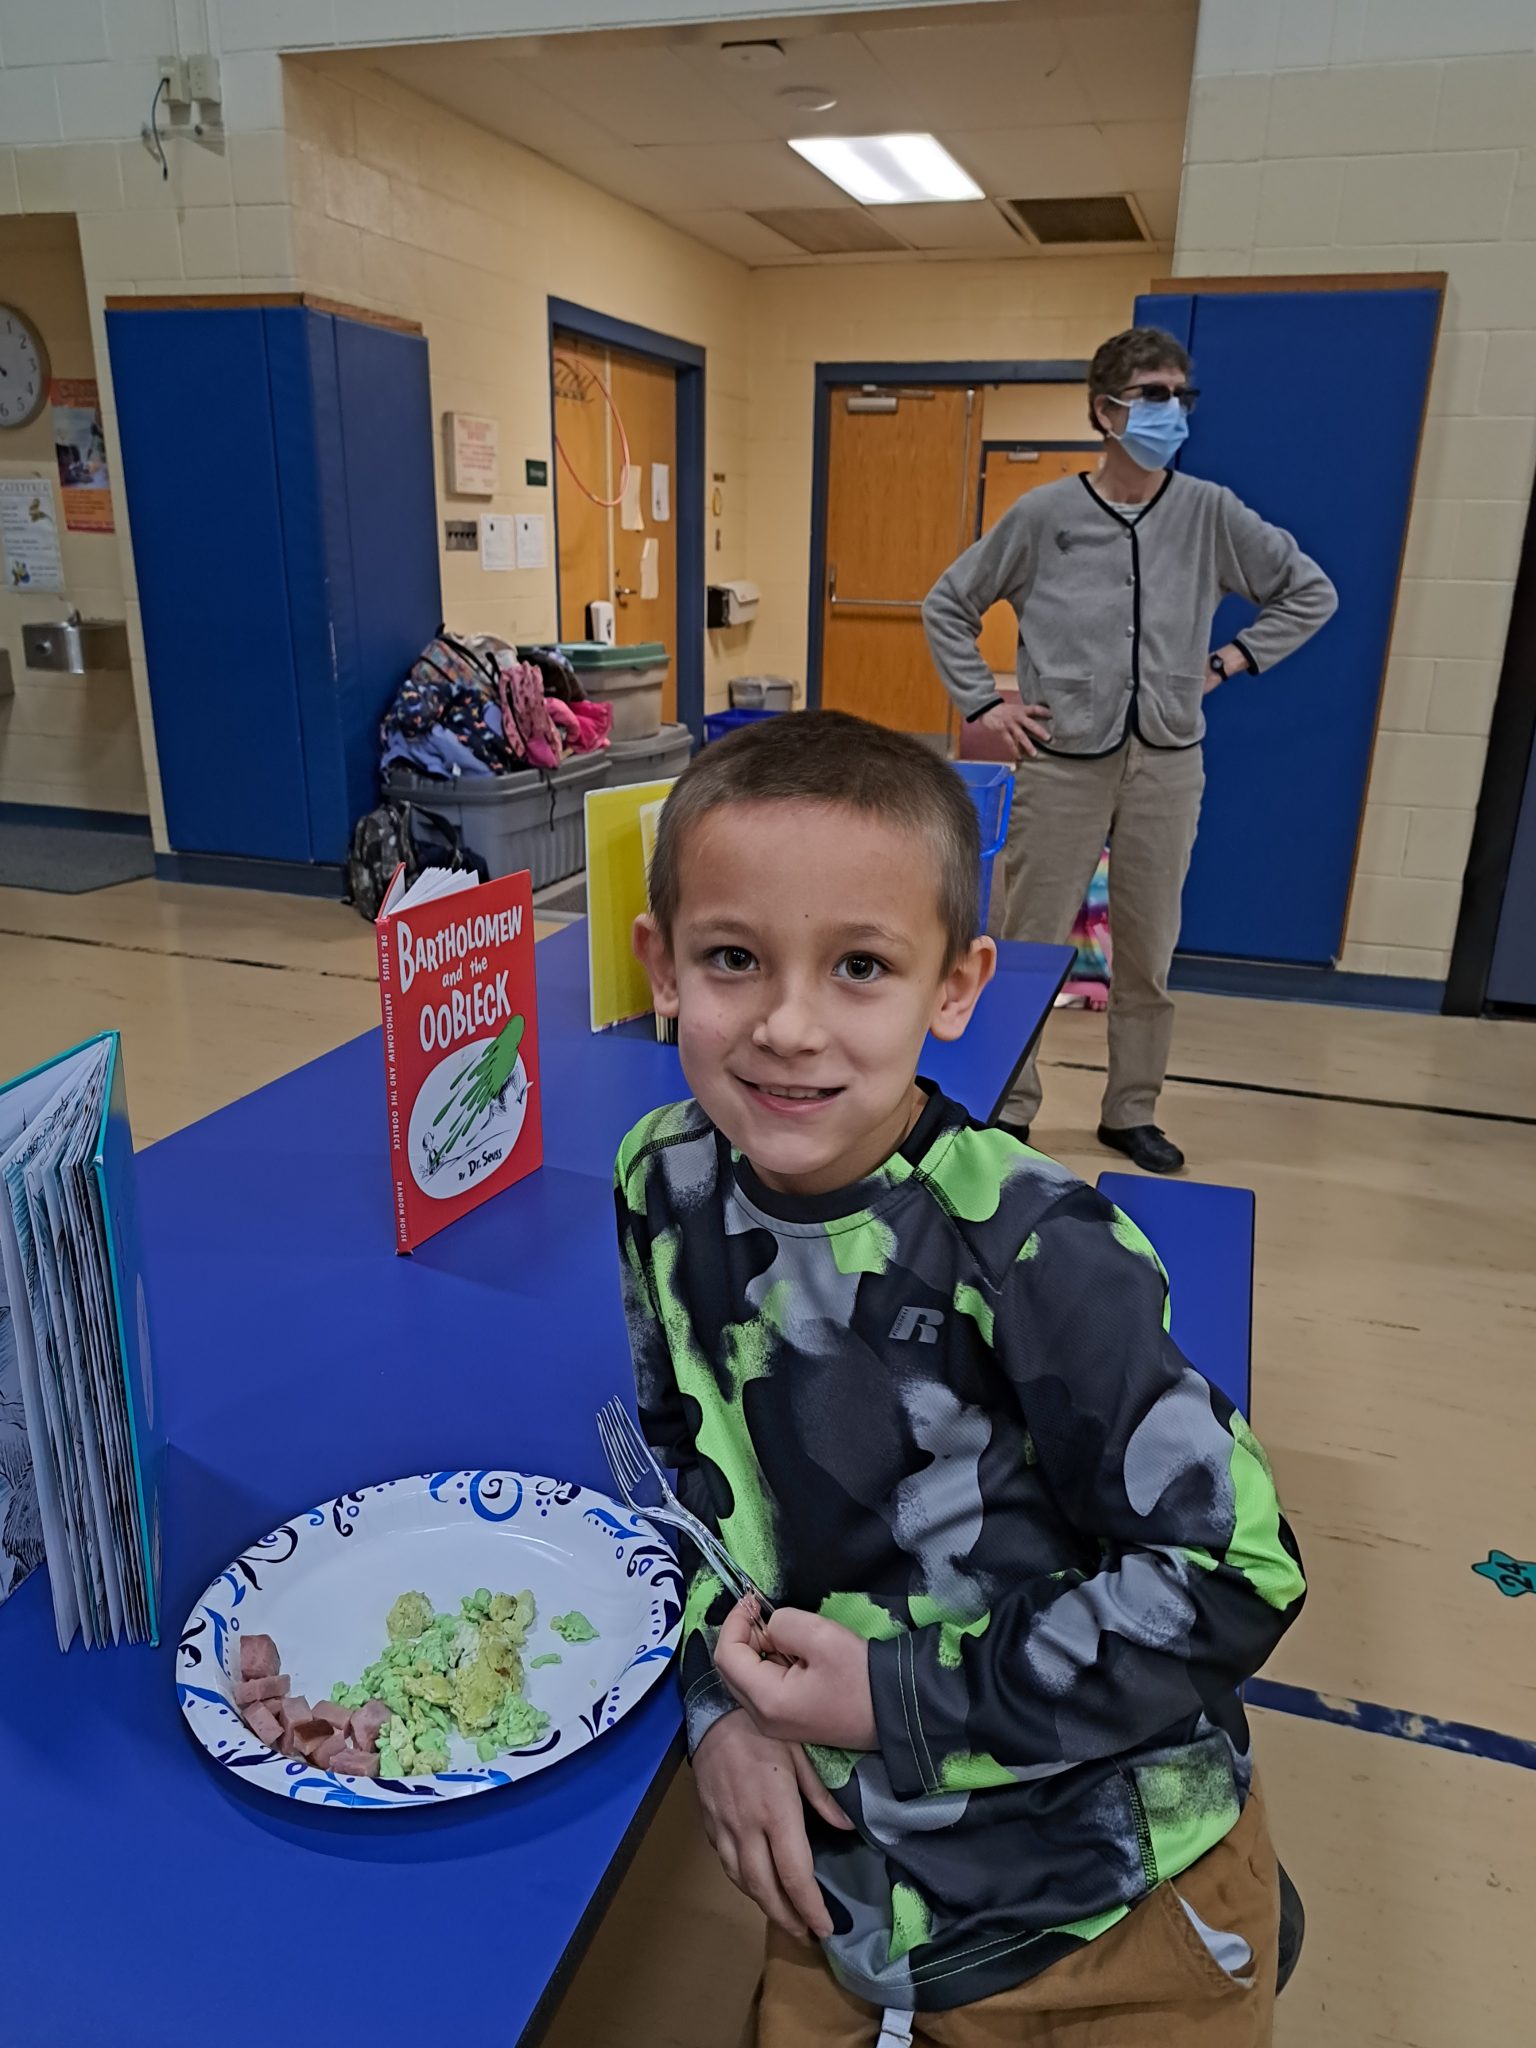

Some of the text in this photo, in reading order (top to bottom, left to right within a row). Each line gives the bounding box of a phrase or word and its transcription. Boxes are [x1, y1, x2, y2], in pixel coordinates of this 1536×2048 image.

[19, 334, 27, 350] 2
[396, 904, 523, 994] BARTHOLOMEW
[442, 956, 488, 988] and the
[419, 969, 512, 1053] OOBLECK
[380, 934, 401, 1150] DR. SEUSS BARTHOLOMEW AND THE OOBLECK
[467, 1159, 482, 1177] Dr.
[481, 1148, 503, 1167] Seuss
[396, 1181, 408, 1243] RANDOM HOUSE
[1494, 1560, 1534, 1590] 24
